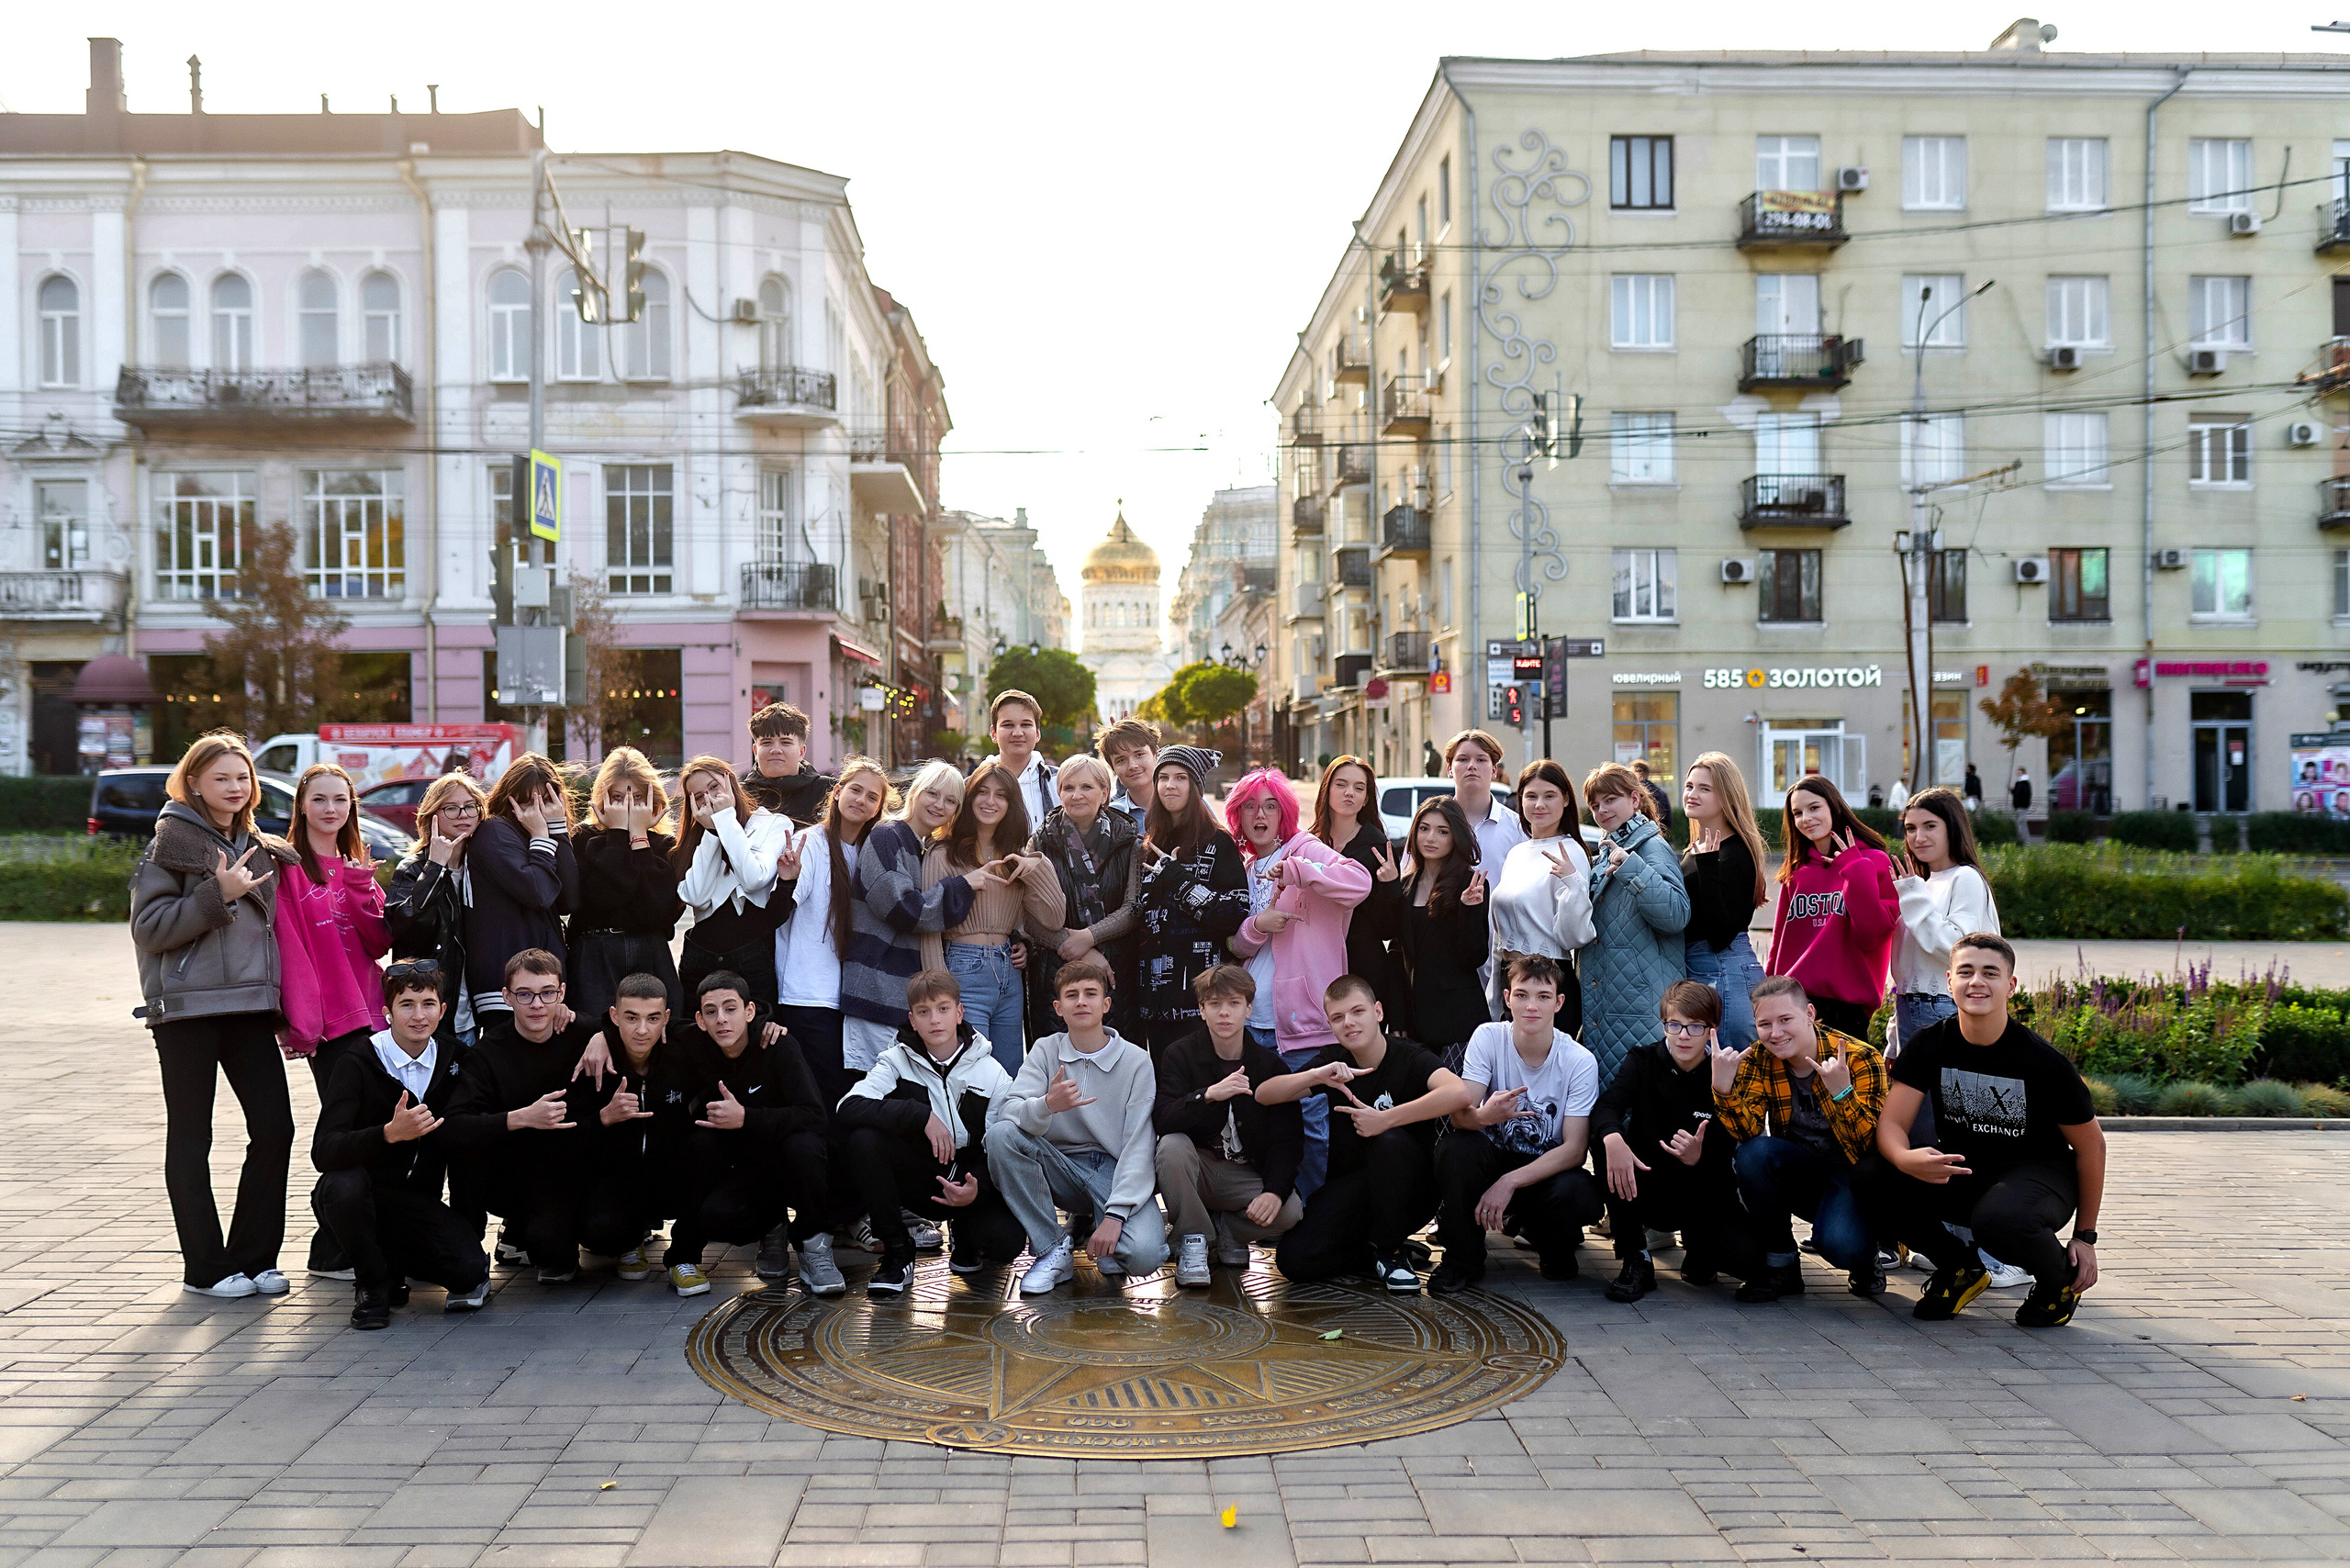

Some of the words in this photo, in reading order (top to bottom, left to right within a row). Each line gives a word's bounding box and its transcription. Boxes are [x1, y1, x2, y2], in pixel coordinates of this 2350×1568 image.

[1515, 659, 1541, 668] ЖДИТЕ
[1612, 671, 1682, 685] ювелирный
[1704, 668, 1743, 688] 585
[1769, 665, 1882, 688] ЗОЛОТОЙ
[1512, 709, 1521, 722] 5
[1693, 1111, 1713, 1119] sports
[1973, 1123, 2026, 1137] EXCHANGE
[1036, 1434, 1154, 1448] МОСКВА
[1176, 1426, 1343, 1447] ВАШИНГТОН
